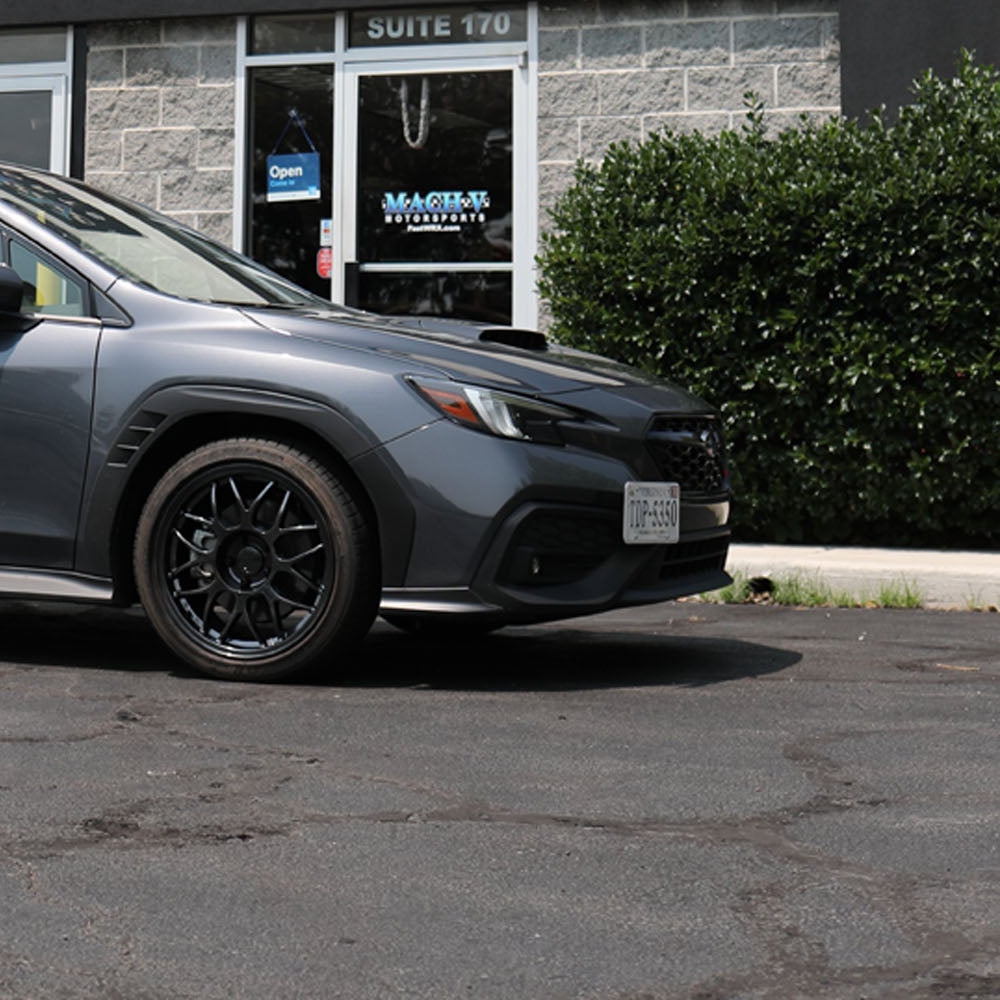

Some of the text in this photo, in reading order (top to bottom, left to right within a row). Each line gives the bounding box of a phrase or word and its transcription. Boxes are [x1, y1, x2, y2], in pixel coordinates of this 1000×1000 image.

[367, 11, 512, 40] SUITE 170
[269, 165, 303, 180] Open
[384, 190, 488, 214] MACH V
[384, 213, 486, 224] MOTORSPORTS
